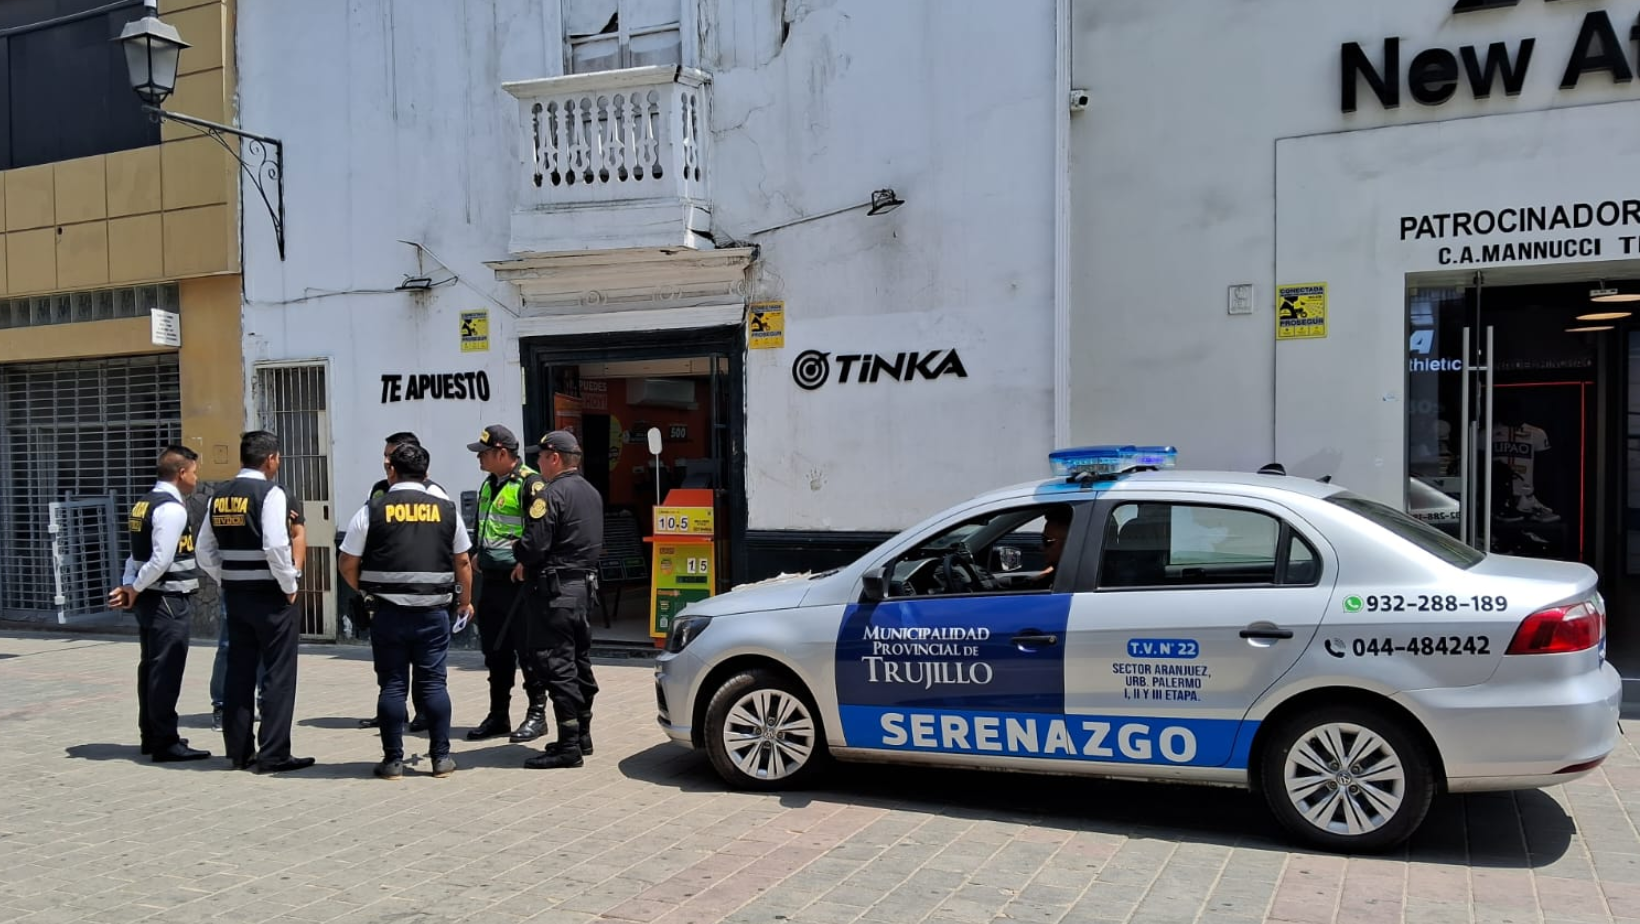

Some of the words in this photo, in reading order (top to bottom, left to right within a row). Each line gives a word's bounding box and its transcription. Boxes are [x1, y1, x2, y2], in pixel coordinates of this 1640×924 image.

[1341, 37, 1535, 113] New
[1400, 199, 1640, 240] PATROCINADOR
[1438, 238, 1601, 265] C.A.MANNUCCI
[1279, 317, 1325, 327] PROSEGUR
[381, 374, 402, 404] TE
[405, 370, 490, 402] APUESTO
[1366, 595, 1508, 612] 932-288-189
[963, 646, 979, 656] DE
[1130, 642, 1157, 655] T.V.
[1178, 643, 1196, 655] 22
[1352, 635, 1491, 656] 044-484242
[861, 656, 993, 690] TRUJILLO
[1112, 663, 1151, 675] SECTOR
[1154, 664, 1211, 679] ARANJUEZ,
[1152, 677, 1202, 689] PALERMO
[1133, 688, 1140, 699] II
[1142, 689, 1150, 699] Y
[1152, 690, 1163, 700] III
[1165, 690, 1202, 702] ETAPA.
[880, 712, 1197, 763] SERENAZGO
